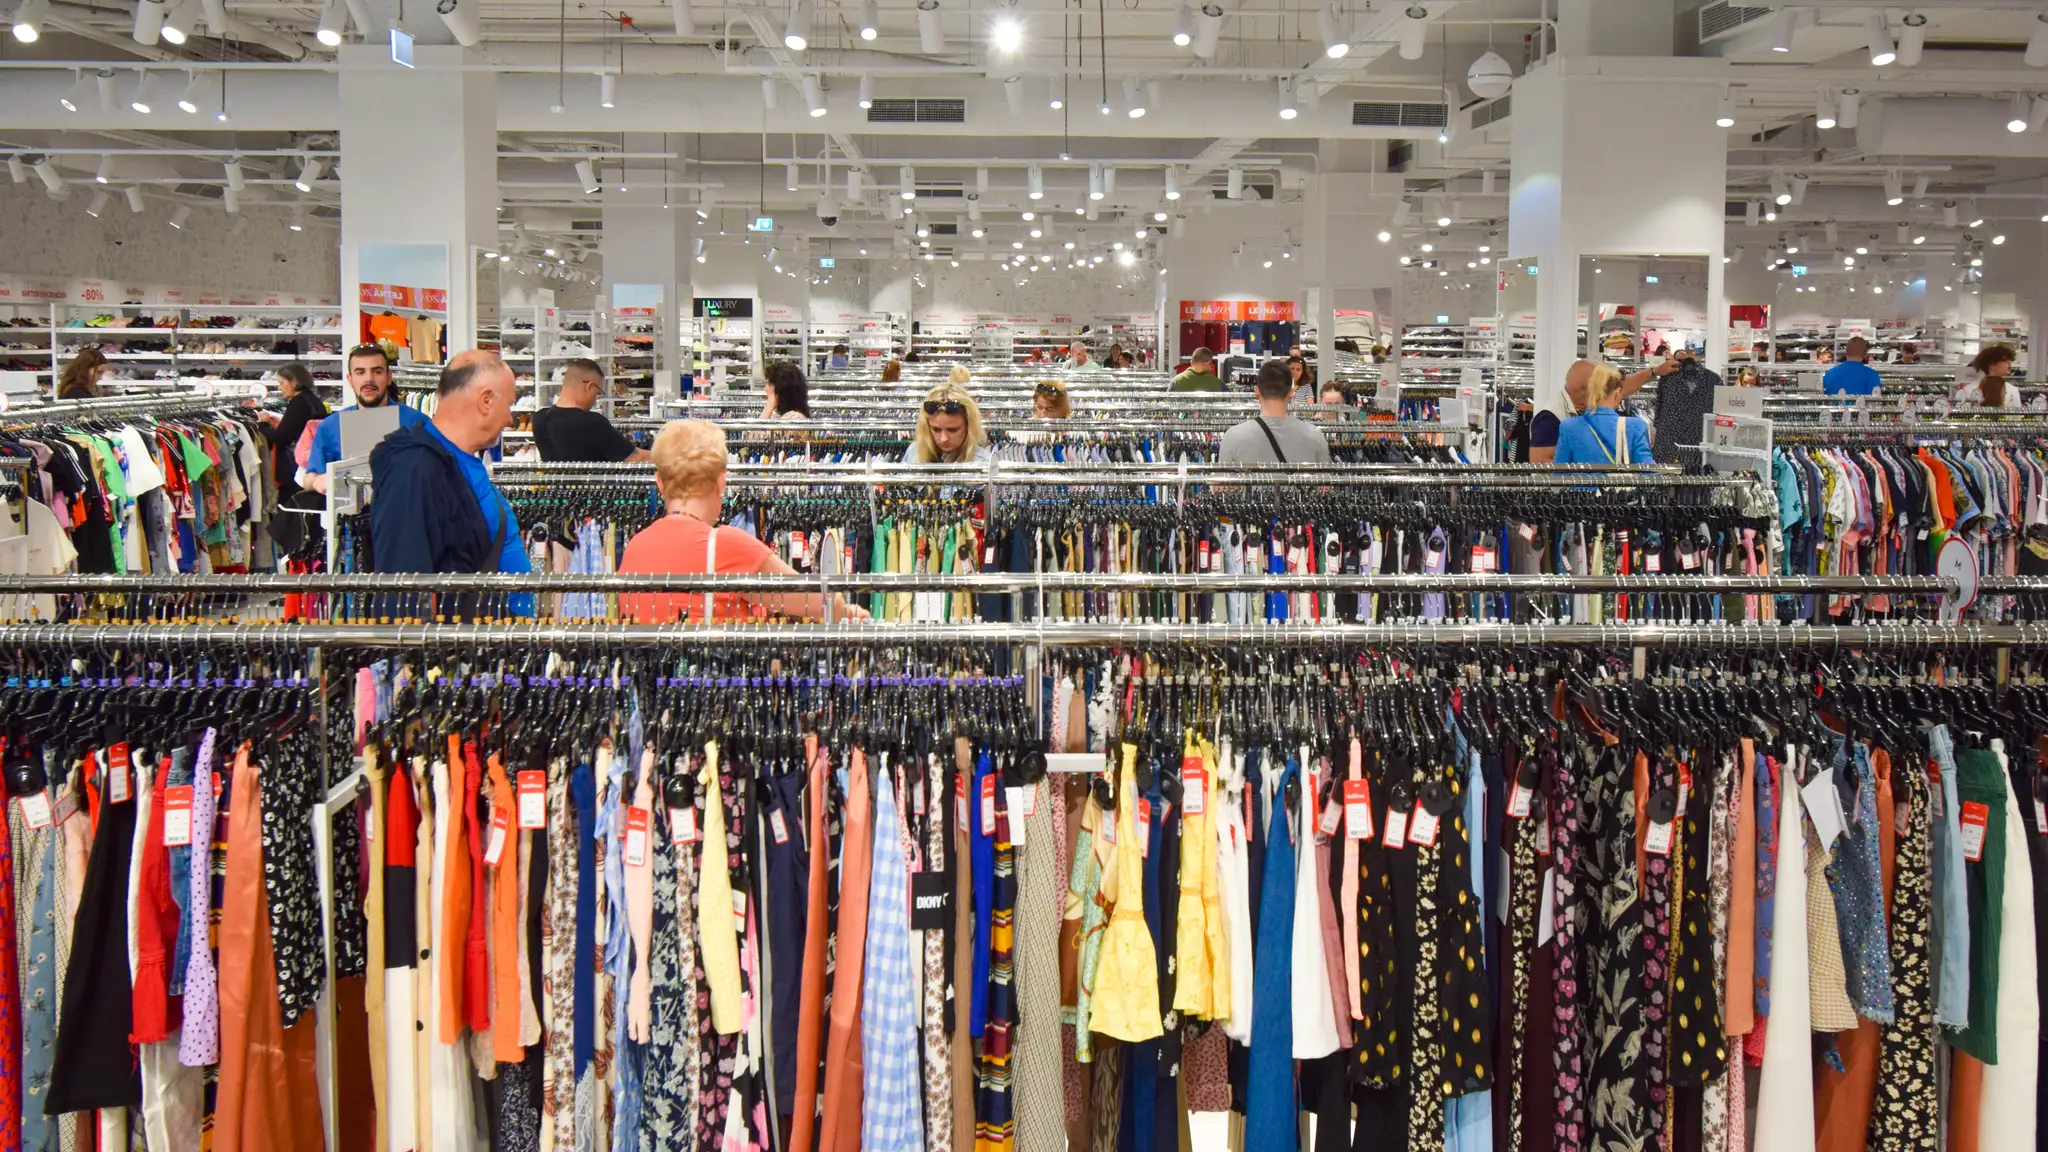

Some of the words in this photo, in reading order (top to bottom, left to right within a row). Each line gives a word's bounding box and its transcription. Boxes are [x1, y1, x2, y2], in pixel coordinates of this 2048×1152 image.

[81, 288, 104, 301] -80%
[702, 300, 738, 309] LUXURY
[1185, 305, 1212, 314] LETNÁ
[1248, 305, 1276, 314] LETNÁ
[1719, 434, 1728, 447] 24
[1954, 560, 1962, 570] M
[916, 895, 942, 910] DKNY
